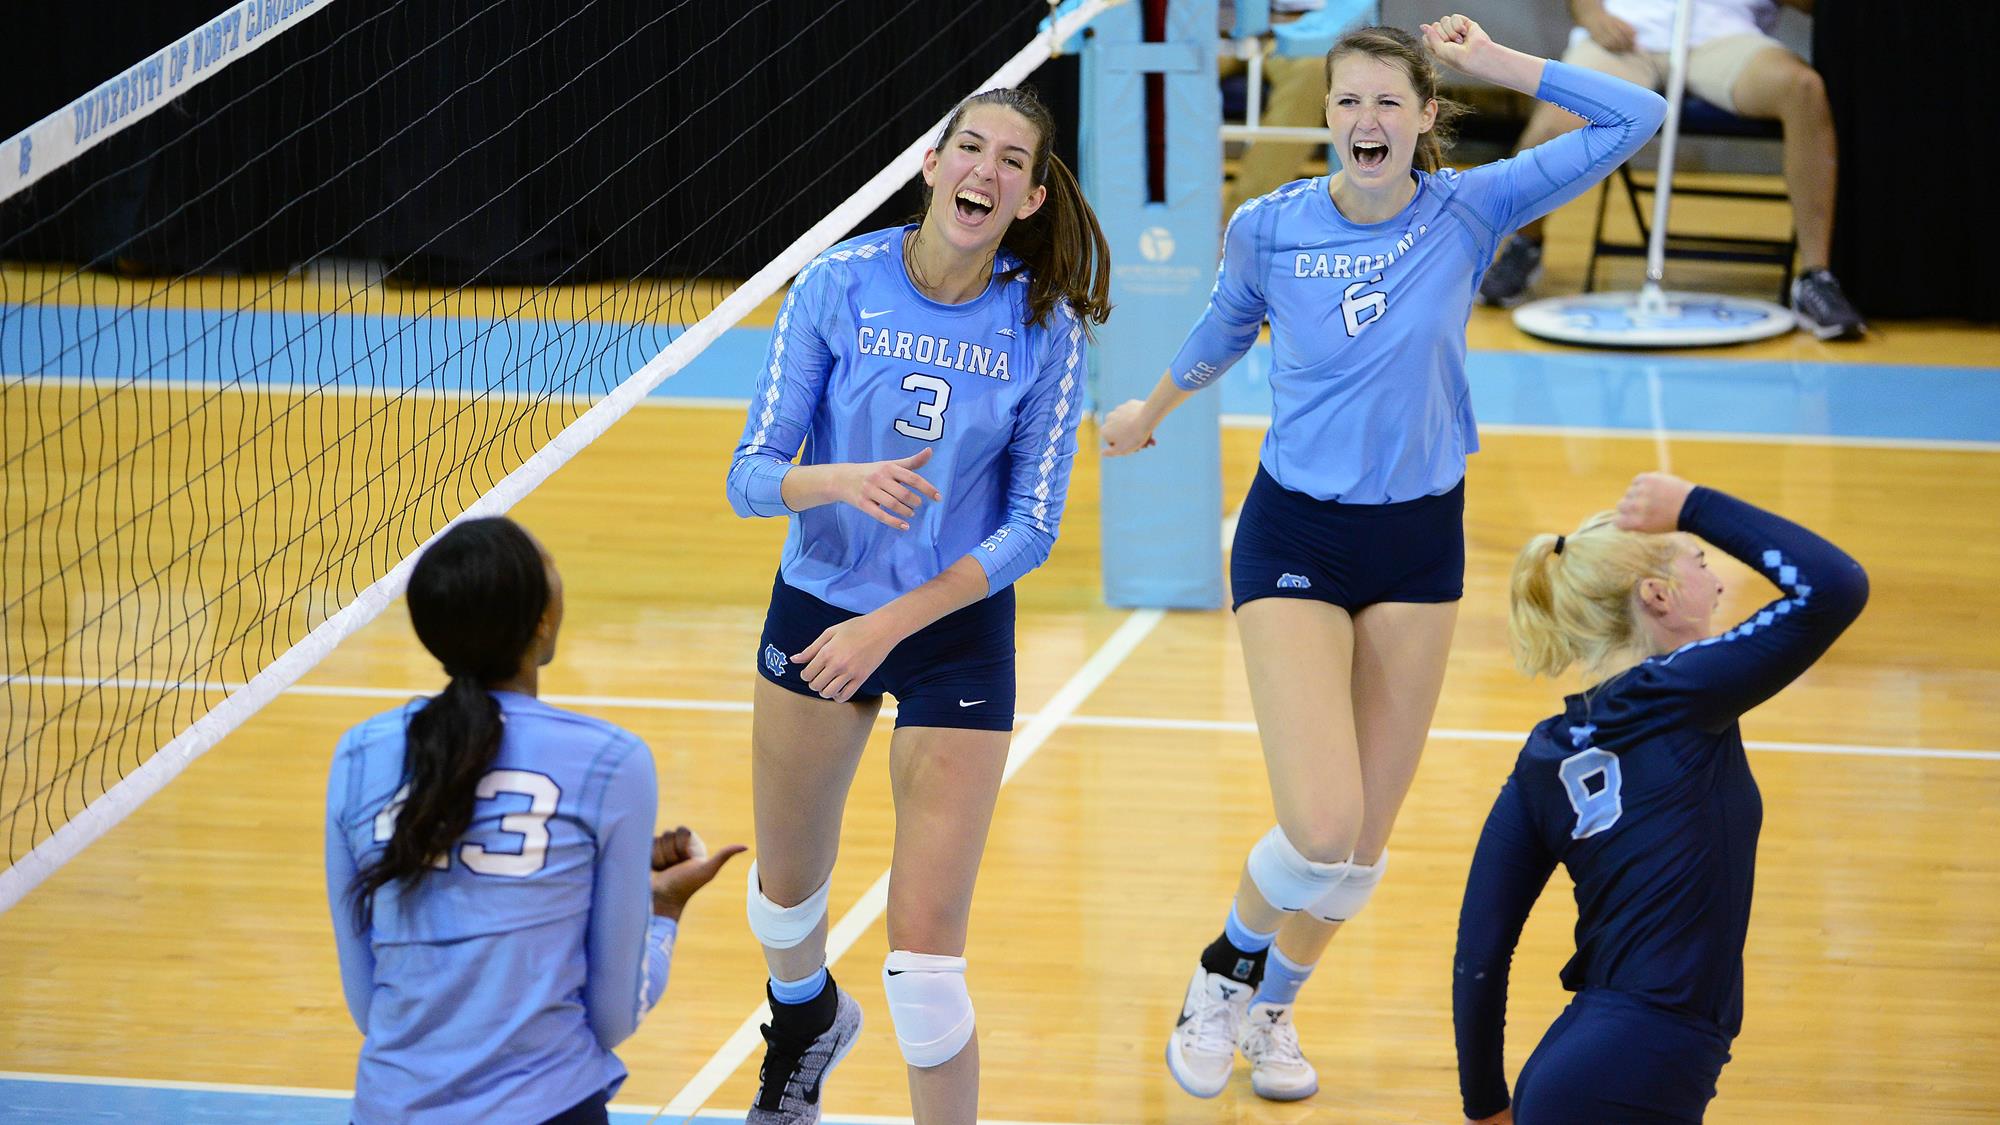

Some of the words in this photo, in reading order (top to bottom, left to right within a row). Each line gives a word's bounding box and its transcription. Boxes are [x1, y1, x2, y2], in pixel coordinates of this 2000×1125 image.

[73, 54, 164, 145] UNIVERSITY
[169, 40, 190, 87] OF
[192, 9, 242, 74] NORTH
[1340, 271, 1388, 338] 6
[858, 326, 1011, 381] CAROLINA
[1183, 360, 1217, 385] TAR
[894, 372, 952, 442] 3
[1558, 746, 1623, 840] 9
